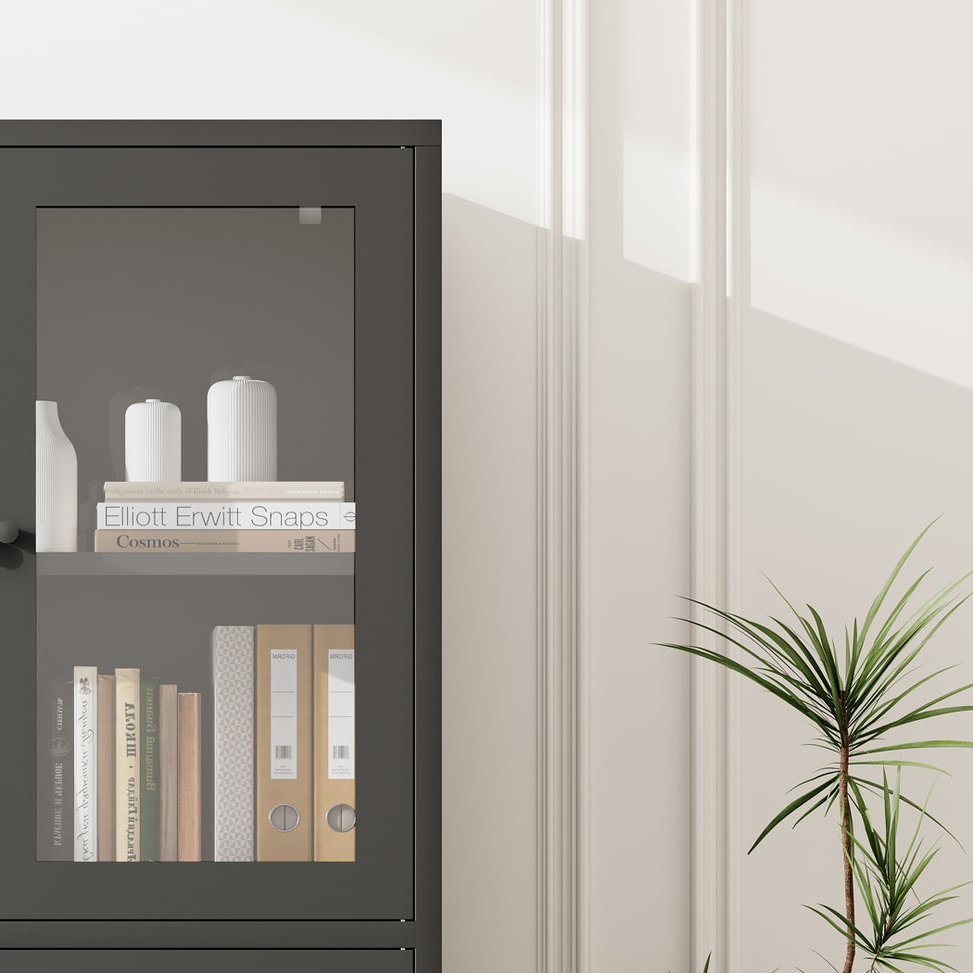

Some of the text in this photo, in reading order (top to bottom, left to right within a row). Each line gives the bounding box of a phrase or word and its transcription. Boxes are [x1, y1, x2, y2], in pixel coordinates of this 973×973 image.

[105, 505, 328, 530] Elliott Erwitt Snaps
[116, 534, 180, 549] Cosmos
